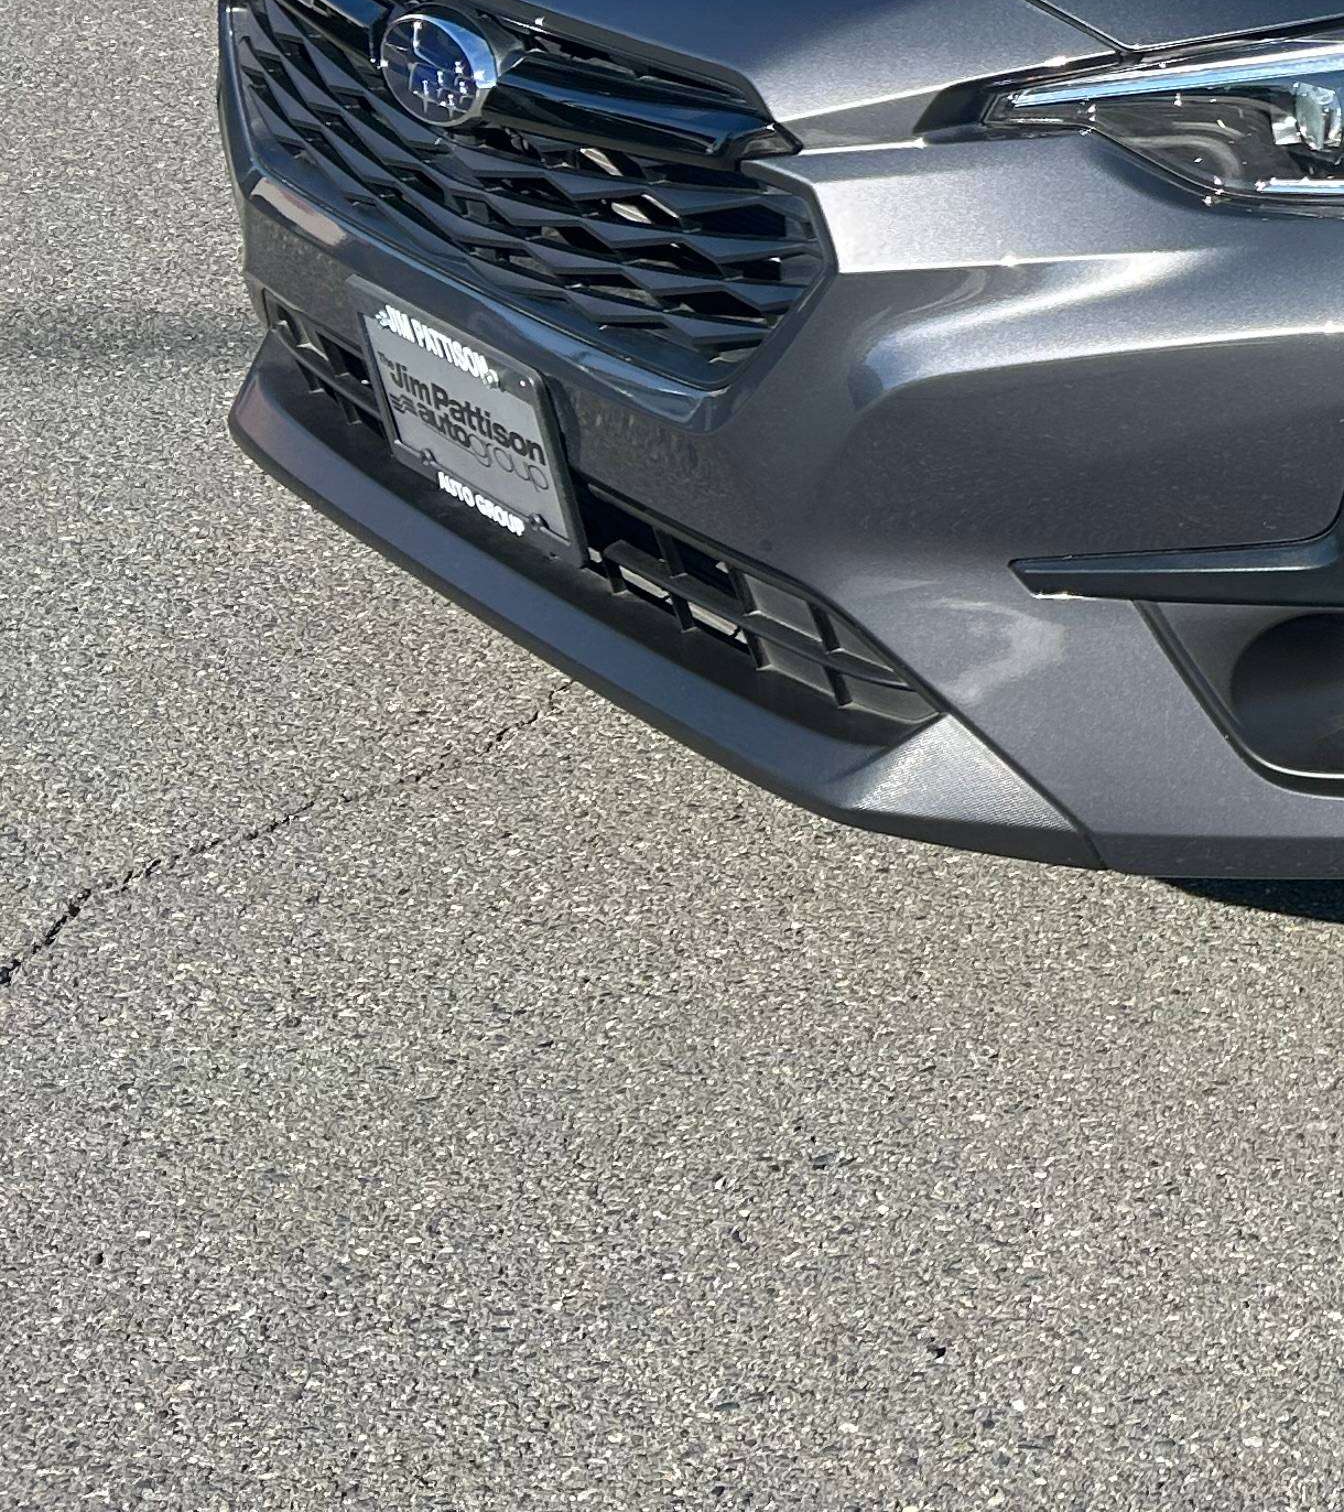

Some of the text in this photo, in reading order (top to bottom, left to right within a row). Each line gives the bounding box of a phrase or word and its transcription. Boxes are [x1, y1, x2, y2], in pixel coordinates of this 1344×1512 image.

[384, 304, 489, 380] JIM PATTISON
[437, 471, 525, 537] AUTO GROUP
